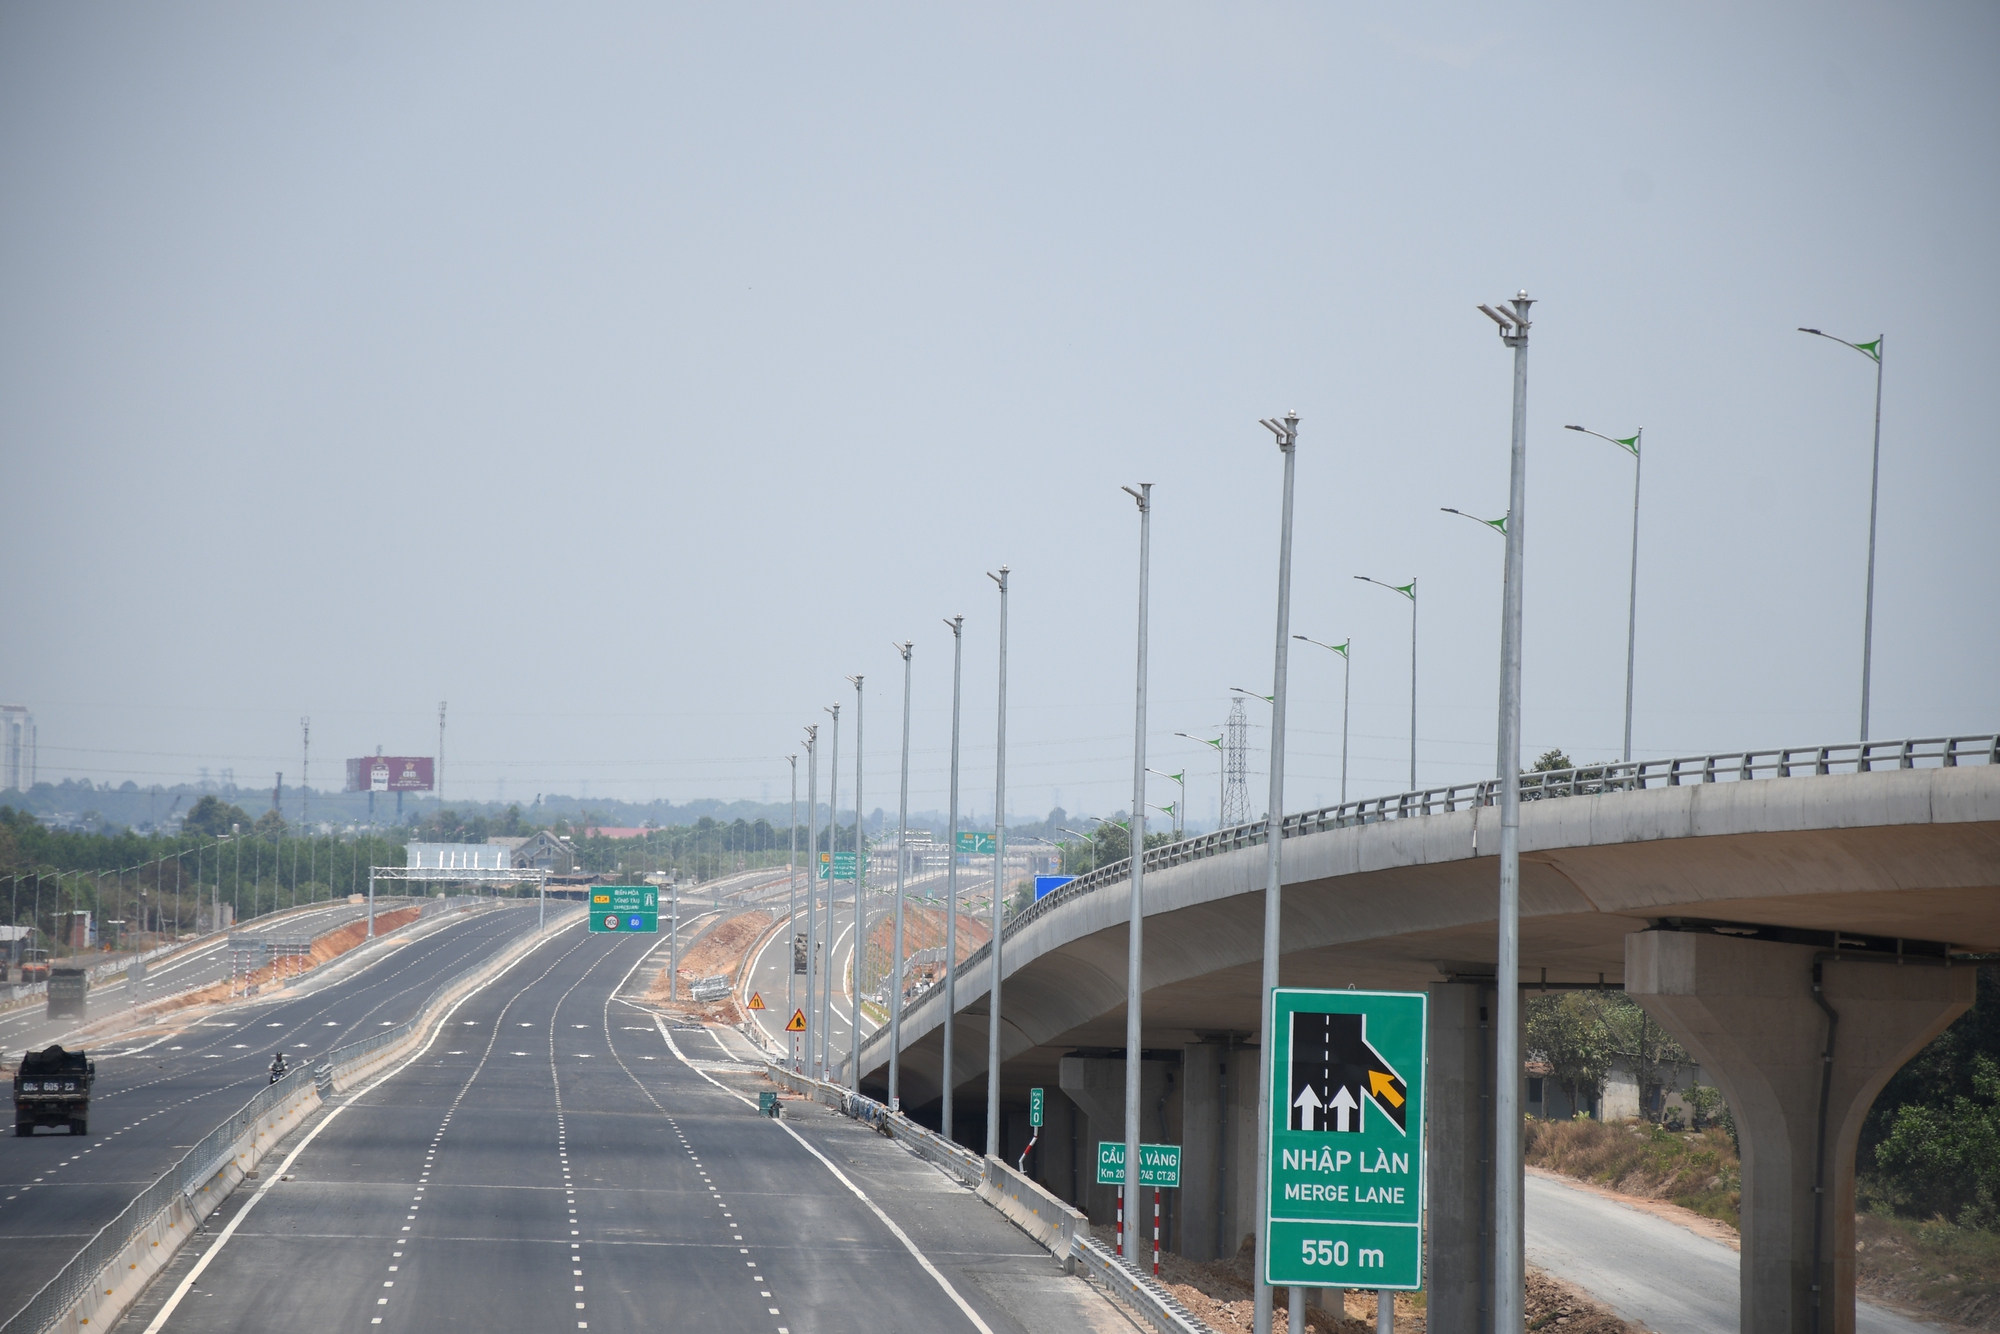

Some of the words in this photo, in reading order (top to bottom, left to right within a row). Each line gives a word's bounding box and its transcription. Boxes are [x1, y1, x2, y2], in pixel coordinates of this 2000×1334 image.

[1102, 1146, 1124, 1164] CẦU
[1146, 1150, 1176, 1166] VÀNG
[1282, 1145, 1352, 1174] NHẬP
[1359, 1147, 1408, 1174] LÀN
[1101, 1168, 1114, 1178] Km
[1284, 1183, 1350, 1202] MERGE
[1355, 1186, 1405, 1204] LANE
[1302, 1240, 1349, 1266] 550
[1358, 1248, 1384, 1268] m
